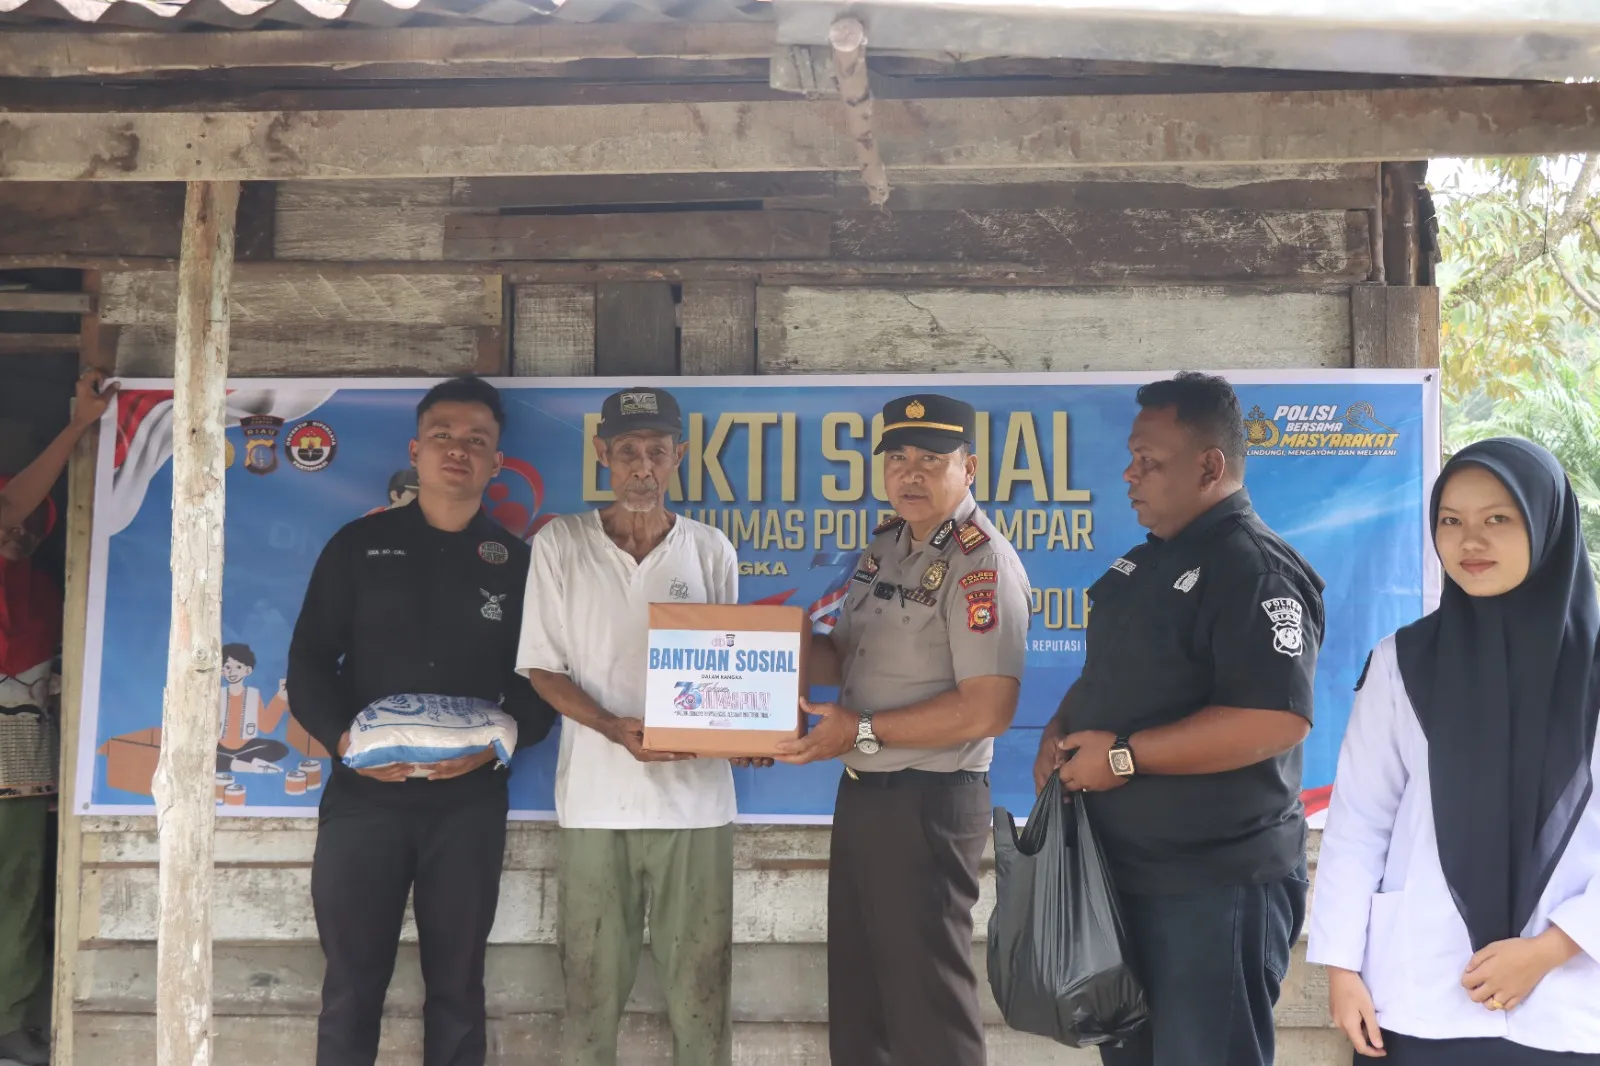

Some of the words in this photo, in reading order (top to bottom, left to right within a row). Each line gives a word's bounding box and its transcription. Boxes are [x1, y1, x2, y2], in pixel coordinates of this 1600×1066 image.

[1273, 405, 1338, 421] POLISI
[1286, 422, 1344, 432] BERSAMA
[1279, 433, 1400, 448] MASYARAKAT
[582, 412, 796, 502] KTI
[821, 411, 1091, 502] SIAL
[990, 509, 1094, 551] MPAR
[738, 561, 788, 576] GKA
[1032, 639, 1081, 652] REPUTASI
[648, 647, 730, 672] BANTUAN
[735, 649, 797, 673] SOSIAL
